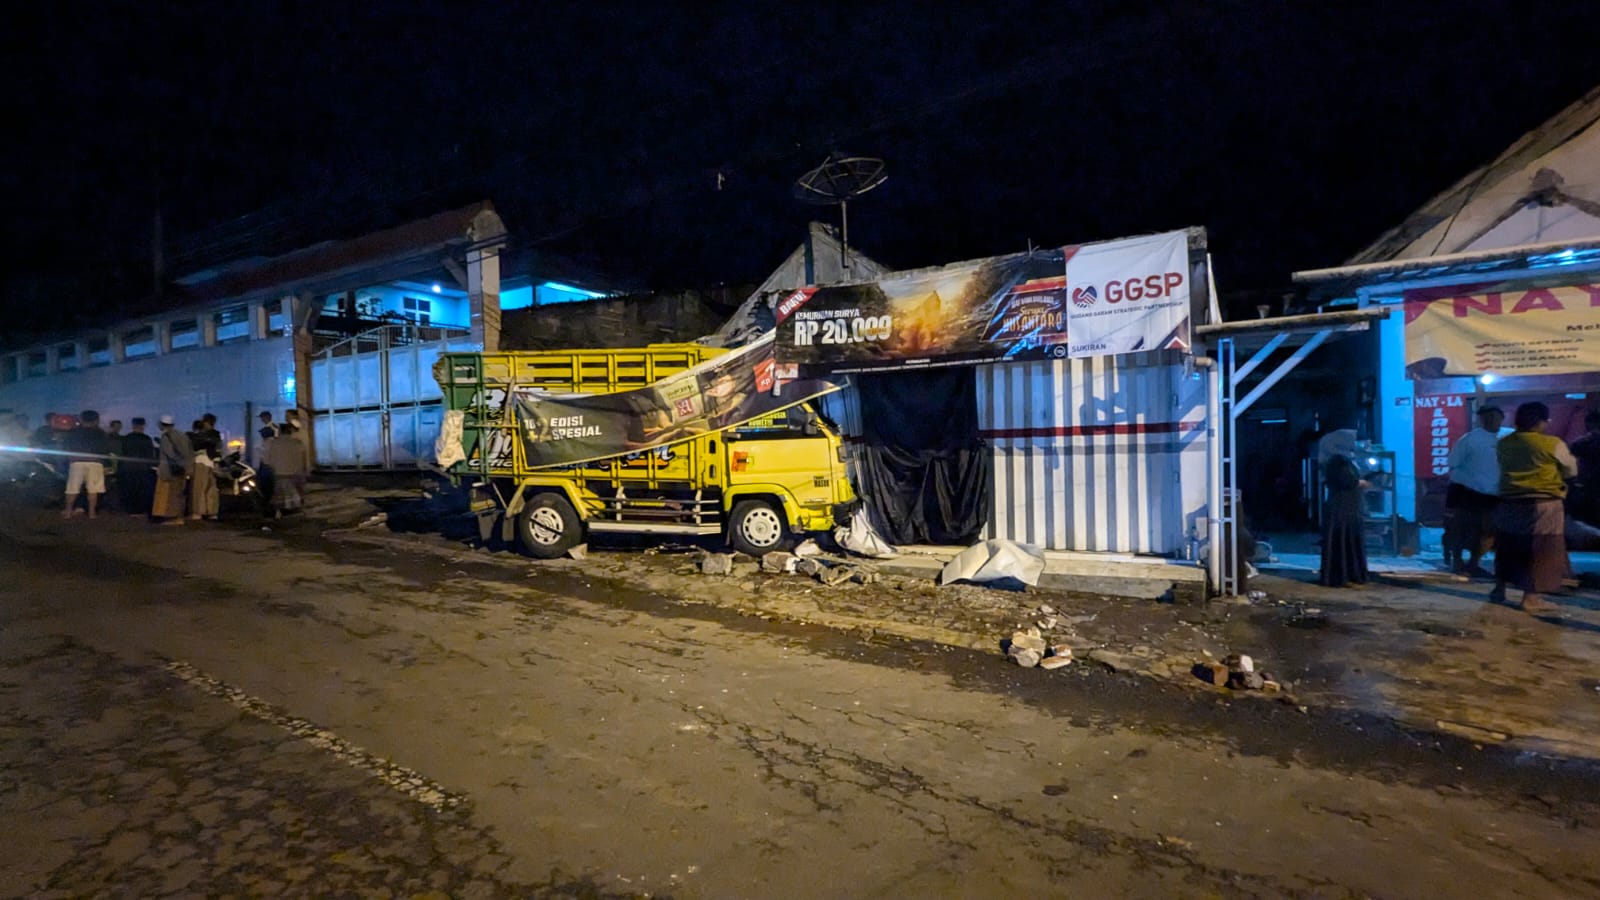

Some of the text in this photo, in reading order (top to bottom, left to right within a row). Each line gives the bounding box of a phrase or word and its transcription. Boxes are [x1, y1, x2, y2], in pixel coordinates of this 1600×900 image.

[1105, 272, 1183, 303] GGSP
[834, 308, 860, 318] SURYA
[794, 320, 818, 346] RP
[1071, 343, 1106, 352] SUKIRAN
[550, 415, 583, 427] EDISI
[552, 425, 602, 440] SPESIAL
